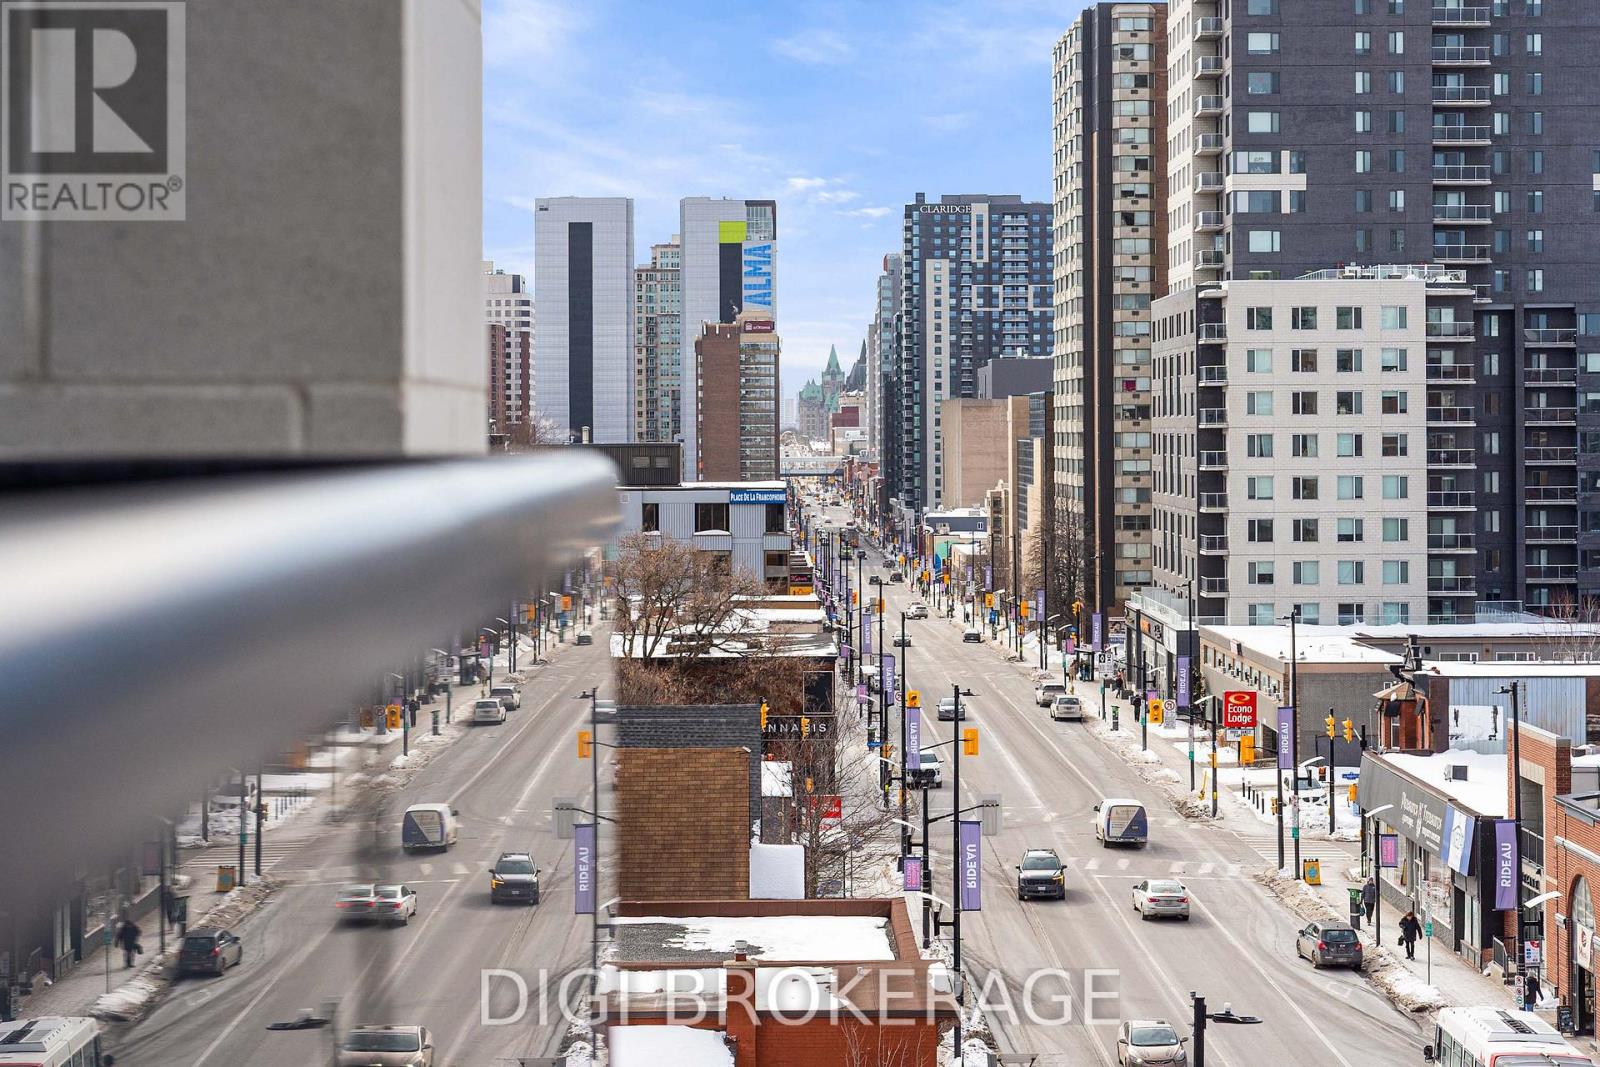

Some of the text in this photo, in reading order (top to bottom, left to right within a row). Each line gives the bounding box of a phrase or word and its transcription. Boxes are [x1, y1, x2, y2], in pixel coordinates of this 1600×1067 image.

[920, 205, 972, 214] CLARIDGE
[744, 244, 772, 306] ALMA
[1228, 704, 1252, 713] Econo
[1228, 713, 1252, 724] Lodge
[763, 723, 827, 733] NNABIS
[1281, 722, 1289, 754] RIDEAU
[579, 847, 590, 892] RIDEAU
[1501, 842, 1512, 887] RIDEAU
